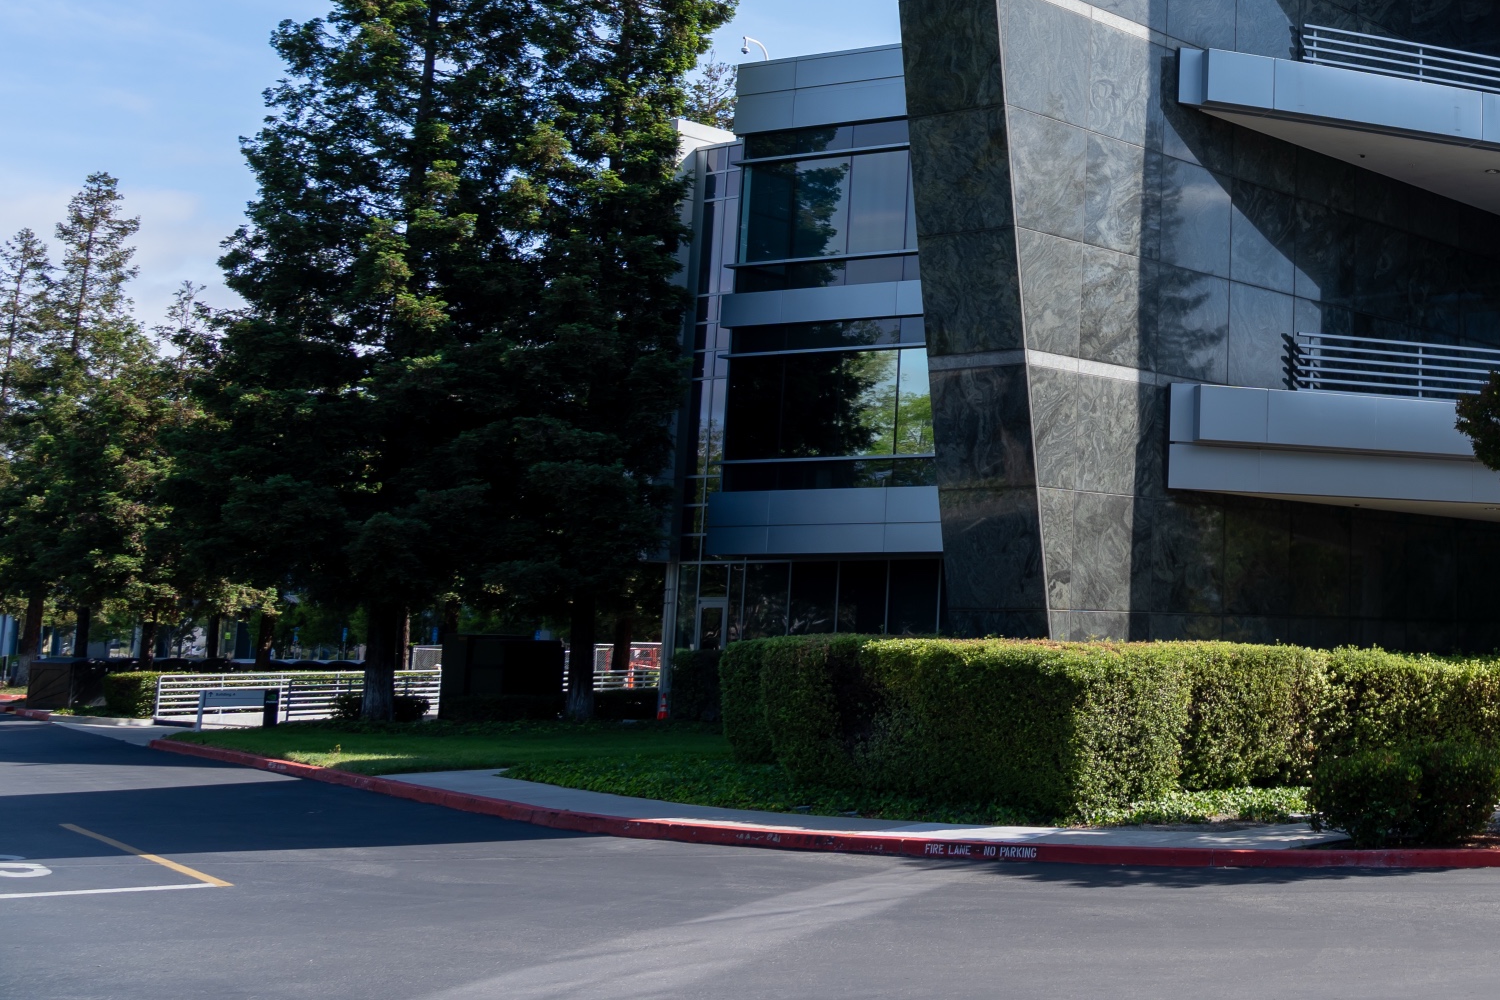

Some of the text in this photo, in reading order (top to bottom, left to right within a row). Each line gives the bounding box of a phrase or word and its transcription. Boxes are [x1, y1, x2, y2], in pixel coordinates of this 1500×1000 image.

[924, 843, 945, 855] FIRE
[948, 844, 972, 856] LANE
[983, 845, 996, 857] NO
[1000, 846, 1037, 859] PARKING
